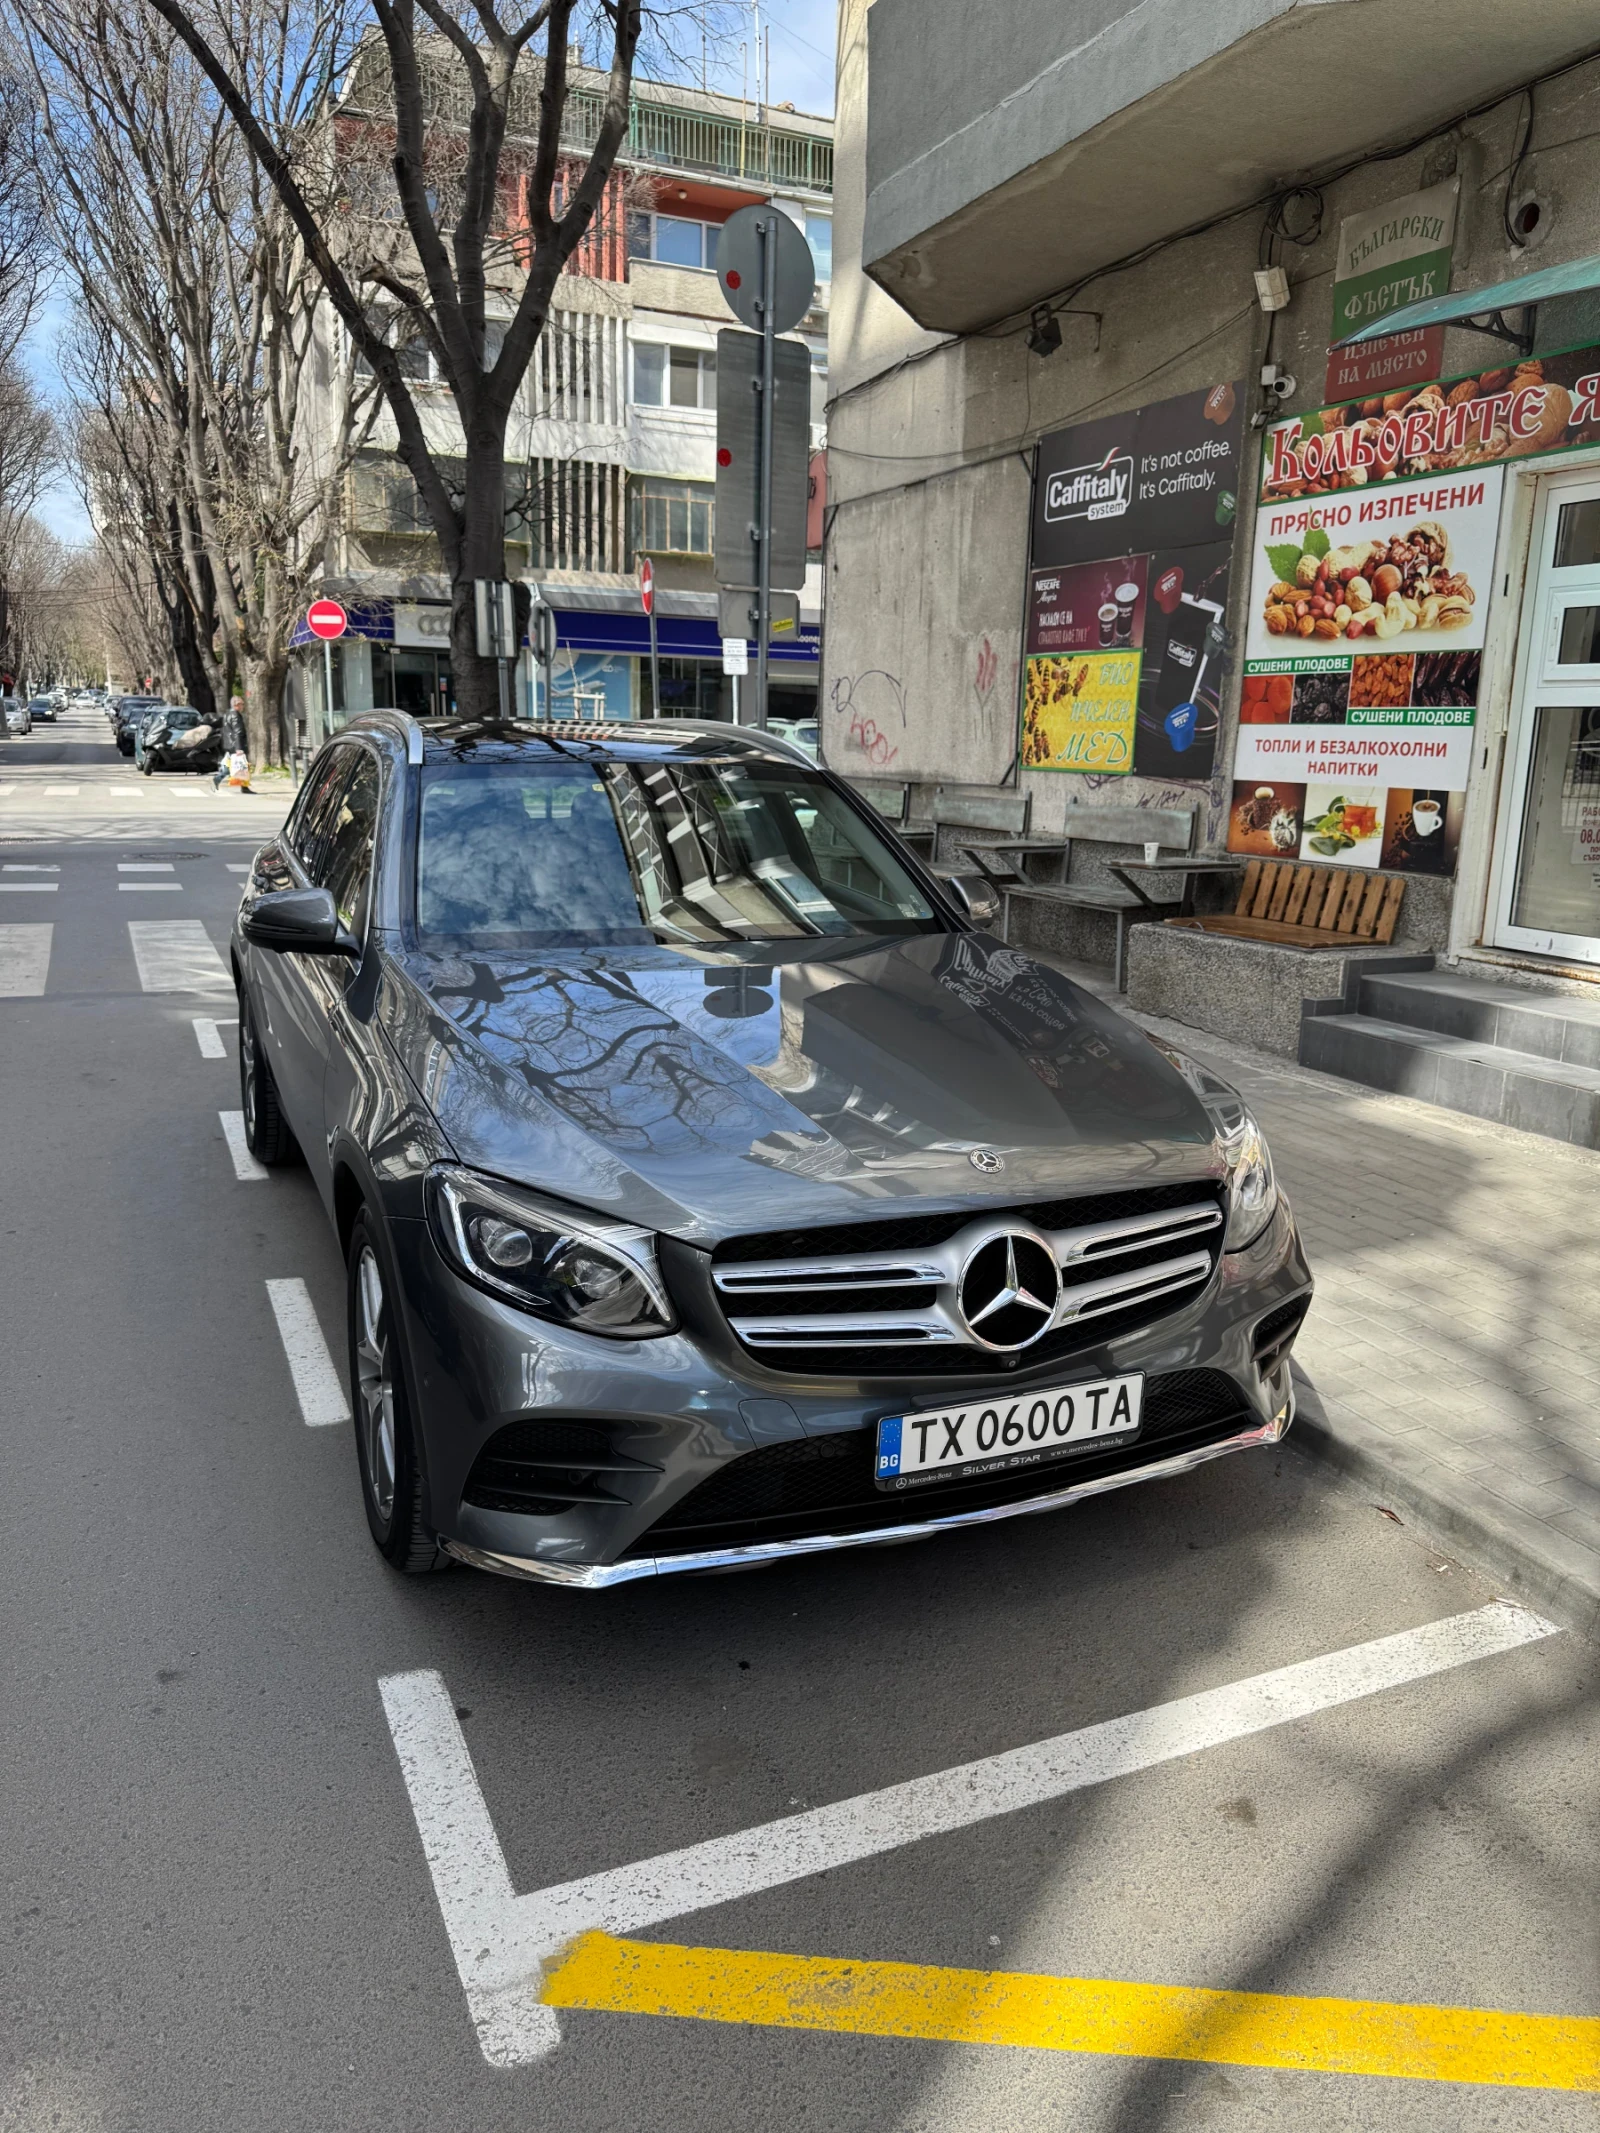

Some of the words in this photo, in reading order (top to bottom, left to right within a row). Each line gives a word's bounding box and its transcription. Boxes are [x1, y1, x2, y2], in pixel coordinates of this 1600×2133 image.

[1349, 216, 1444, 271] БЪЛГАРСКИ
[1344, 270, 1436, 319] ФЪСТЪК
[1338, 366, 1359, 385] НА
[1366, 348, 1428, 379] МЯСТО
[1140, 454, 1158, 474] It's
[1161, 450, 1182, 468] not
[1185, 440, 1232, 462] coffee.
[1050, 468, 1128, 508] Caffitaly
[1139, 482, 1156, 500] It's
[1158, 468, 1216, 496] Caffitaly.
[1090, 501, 1124, 518] system
[1270, 505, 1352, 536] ПРЯСНО
[1358, 482, 1486, 523] ИЗПЕЧЕНИ
[1099, 662, 1134, 686] БИО
[1248, 660, 1292, 673] СУШЕНИ
[1294, 658, 1348, 672] ПЛОДОВЕ
[1070, 700, 1131, 723] ПЧЕЛЕН
[1351, 711, 1404, 723] СУШЕНИ
[1406, 711, 1470, 725] ПЛОДОВЕ
[1056, 730, 1128, 764] МЕД
[1256, 739, 1300, 753] ТОПЛИ
[1306, 740, 1315, 754] И
[1320, 740, 1448, 758] БЕЗАЛКОХОЛНИ
[1308, 761, 1378, 776] НАПИТКИ
[912, 1414, 967, 1464] TX
[976, 1395, 1074, 1451] 0600
[1086, 1384, 1131, 1430] TA
[880, 1454, 898, 1469] BG
[908, 1472, 952, 1486] Mercedes-Benz
[962, 1461, 1005, 1475] SILVER
[1010, 1454, 1041, 1466] STAR
